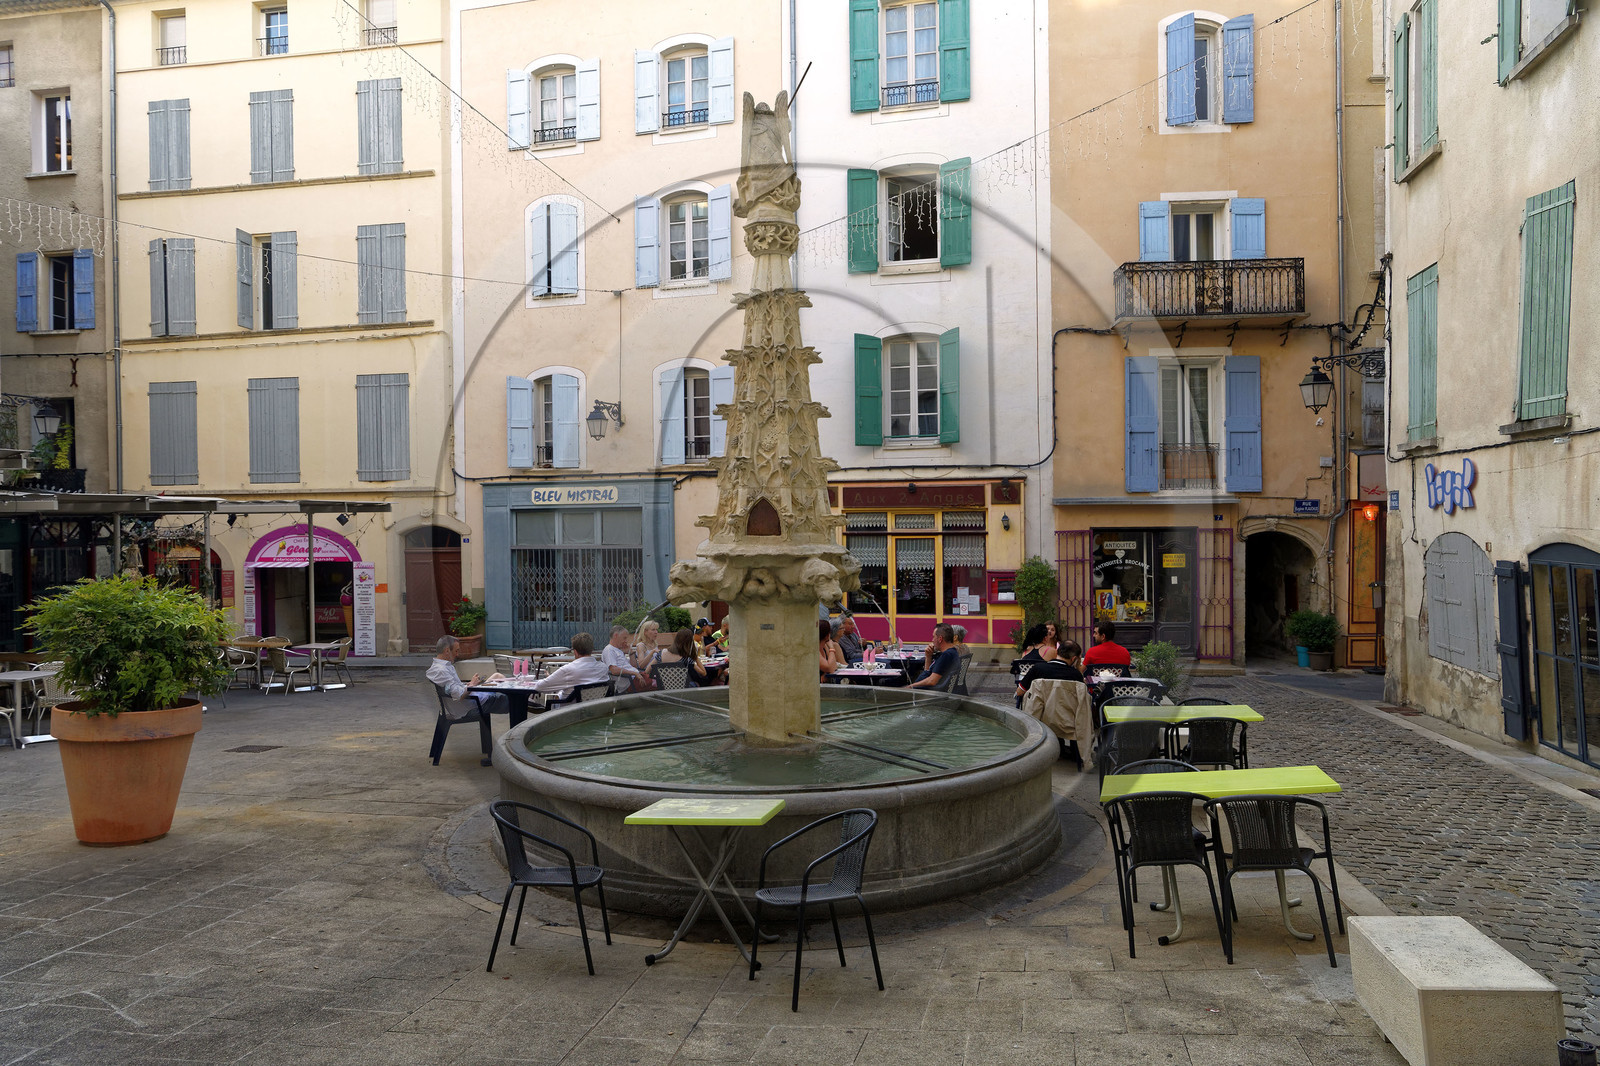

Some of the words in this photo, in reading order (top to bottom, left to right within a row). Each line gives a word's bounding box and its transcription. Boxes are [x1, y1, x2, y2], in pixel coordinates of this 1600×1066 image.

[534, 490, 562, 502] BLEU
[567, 489, 615, 501] MISTRAL
[854, 493, 885, 504] Aux
[900, 492, 907, 503] 2
